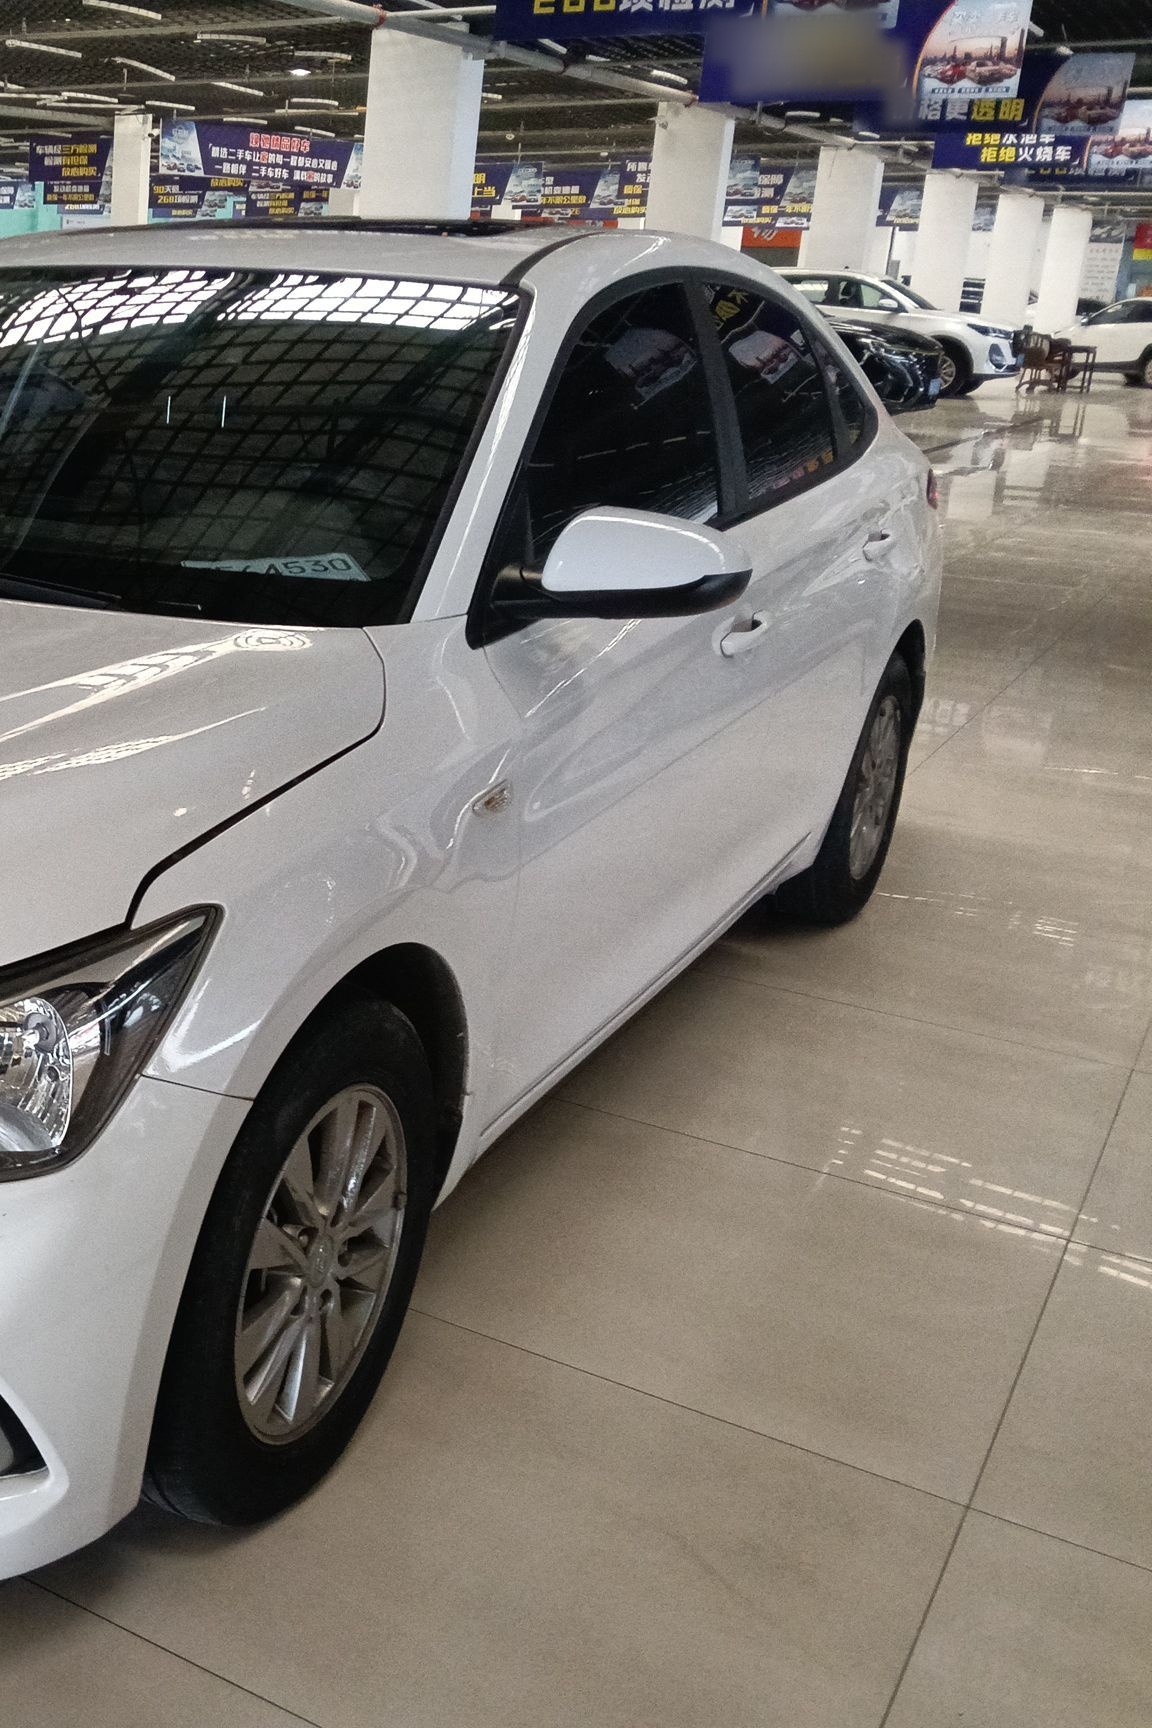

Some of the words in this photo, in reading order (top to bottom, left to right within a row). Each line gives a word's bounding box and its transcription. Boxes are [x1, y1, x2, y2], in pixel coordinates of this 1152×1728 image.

[979, 145, 1073, 163] 拒绝火烧车
